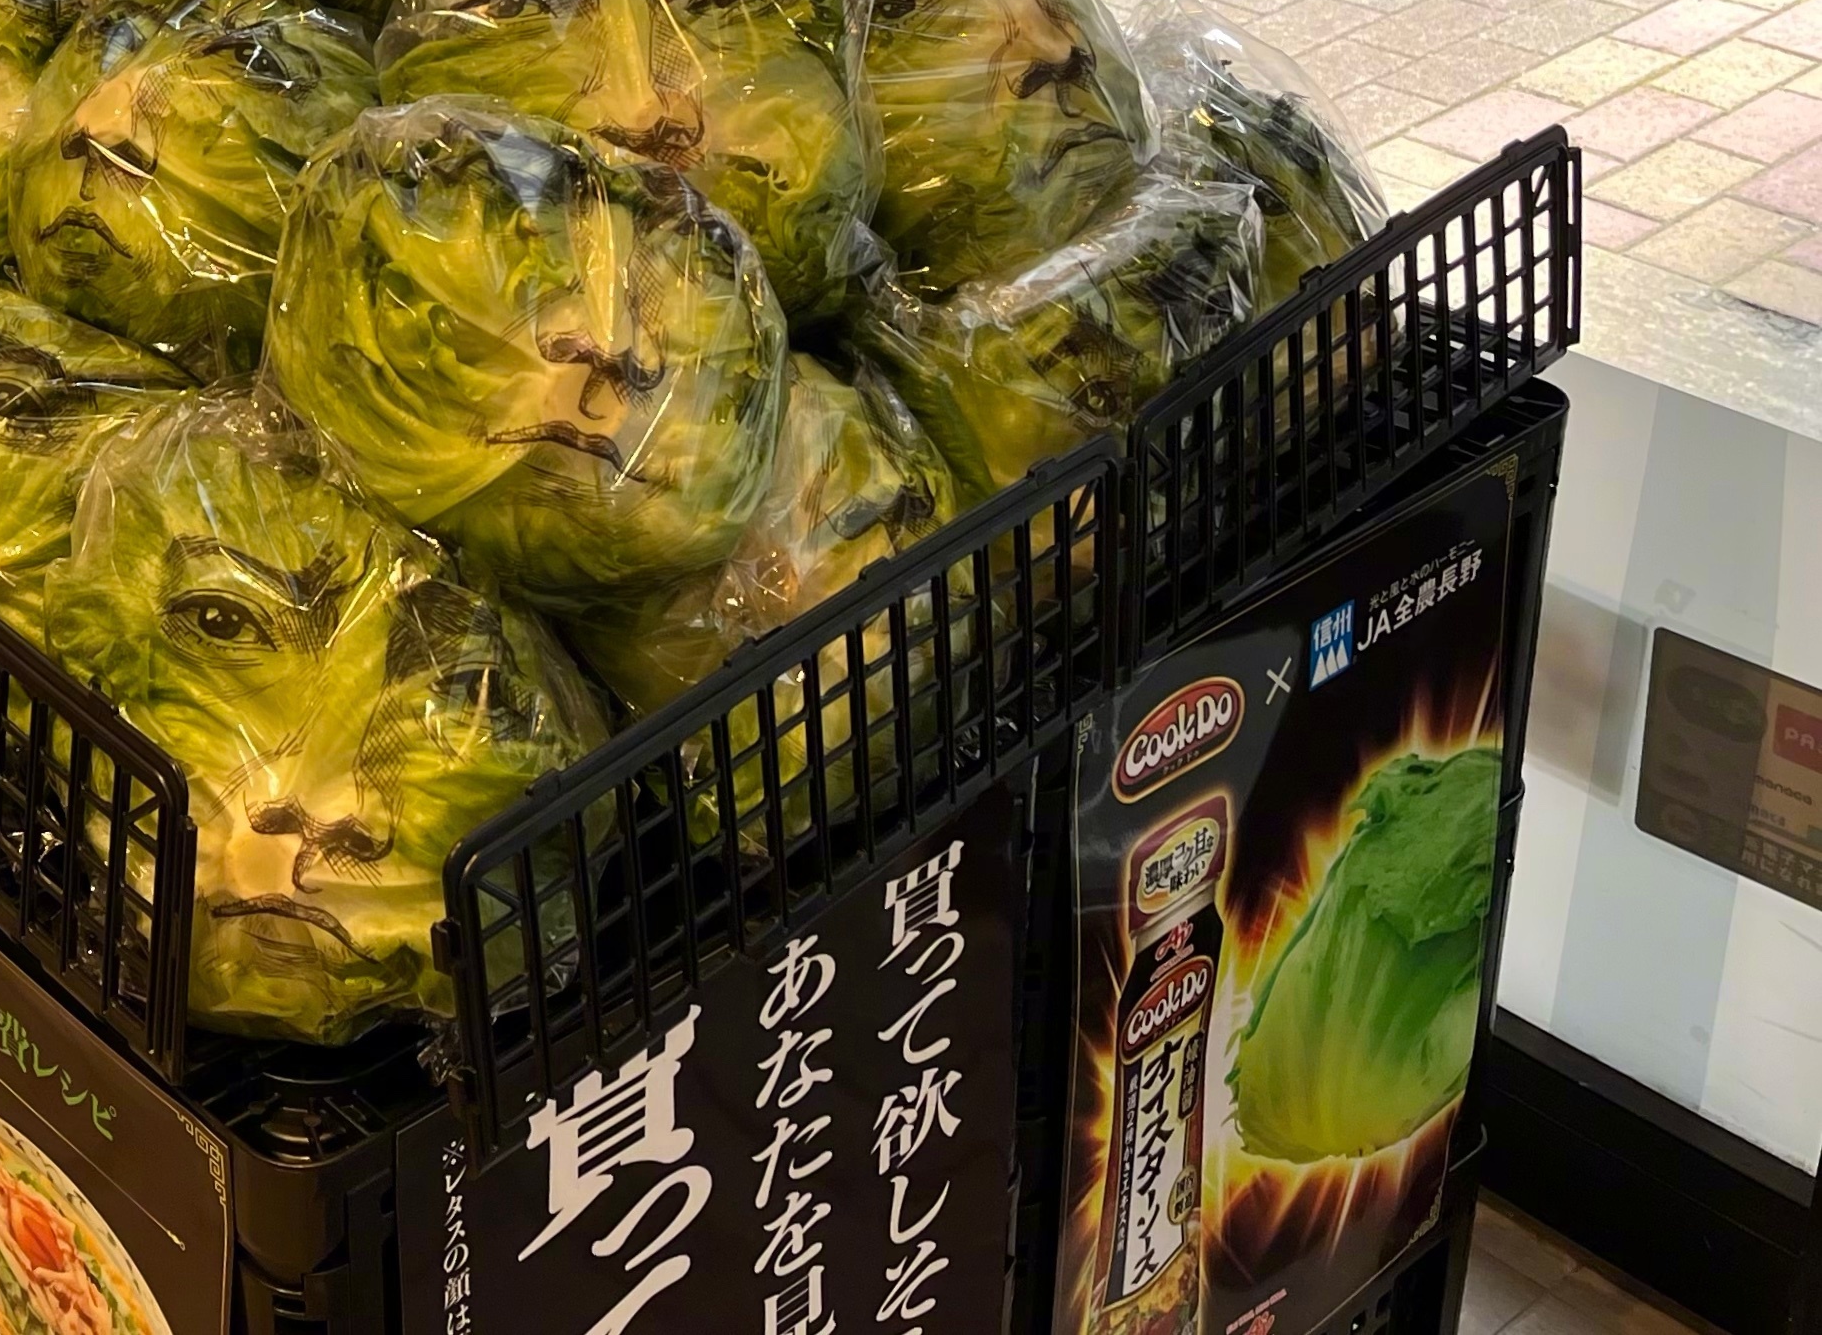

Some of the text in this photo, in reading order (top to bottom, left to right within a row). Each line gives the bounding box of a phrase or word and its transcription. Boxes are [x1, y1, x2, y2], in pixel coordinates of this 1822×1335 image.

[1314, 604, 1352, 652] 信州
[1357, 549, 1482, 652] JA全農長野
[1784, 726, 1822, 753] PA
[871, 840, 965, 1335] 買って欲しそ
[1131, 1036, 1185, 1284] オイスターソース
[442, 1137, 471, 1335] ※レタスの顔は
